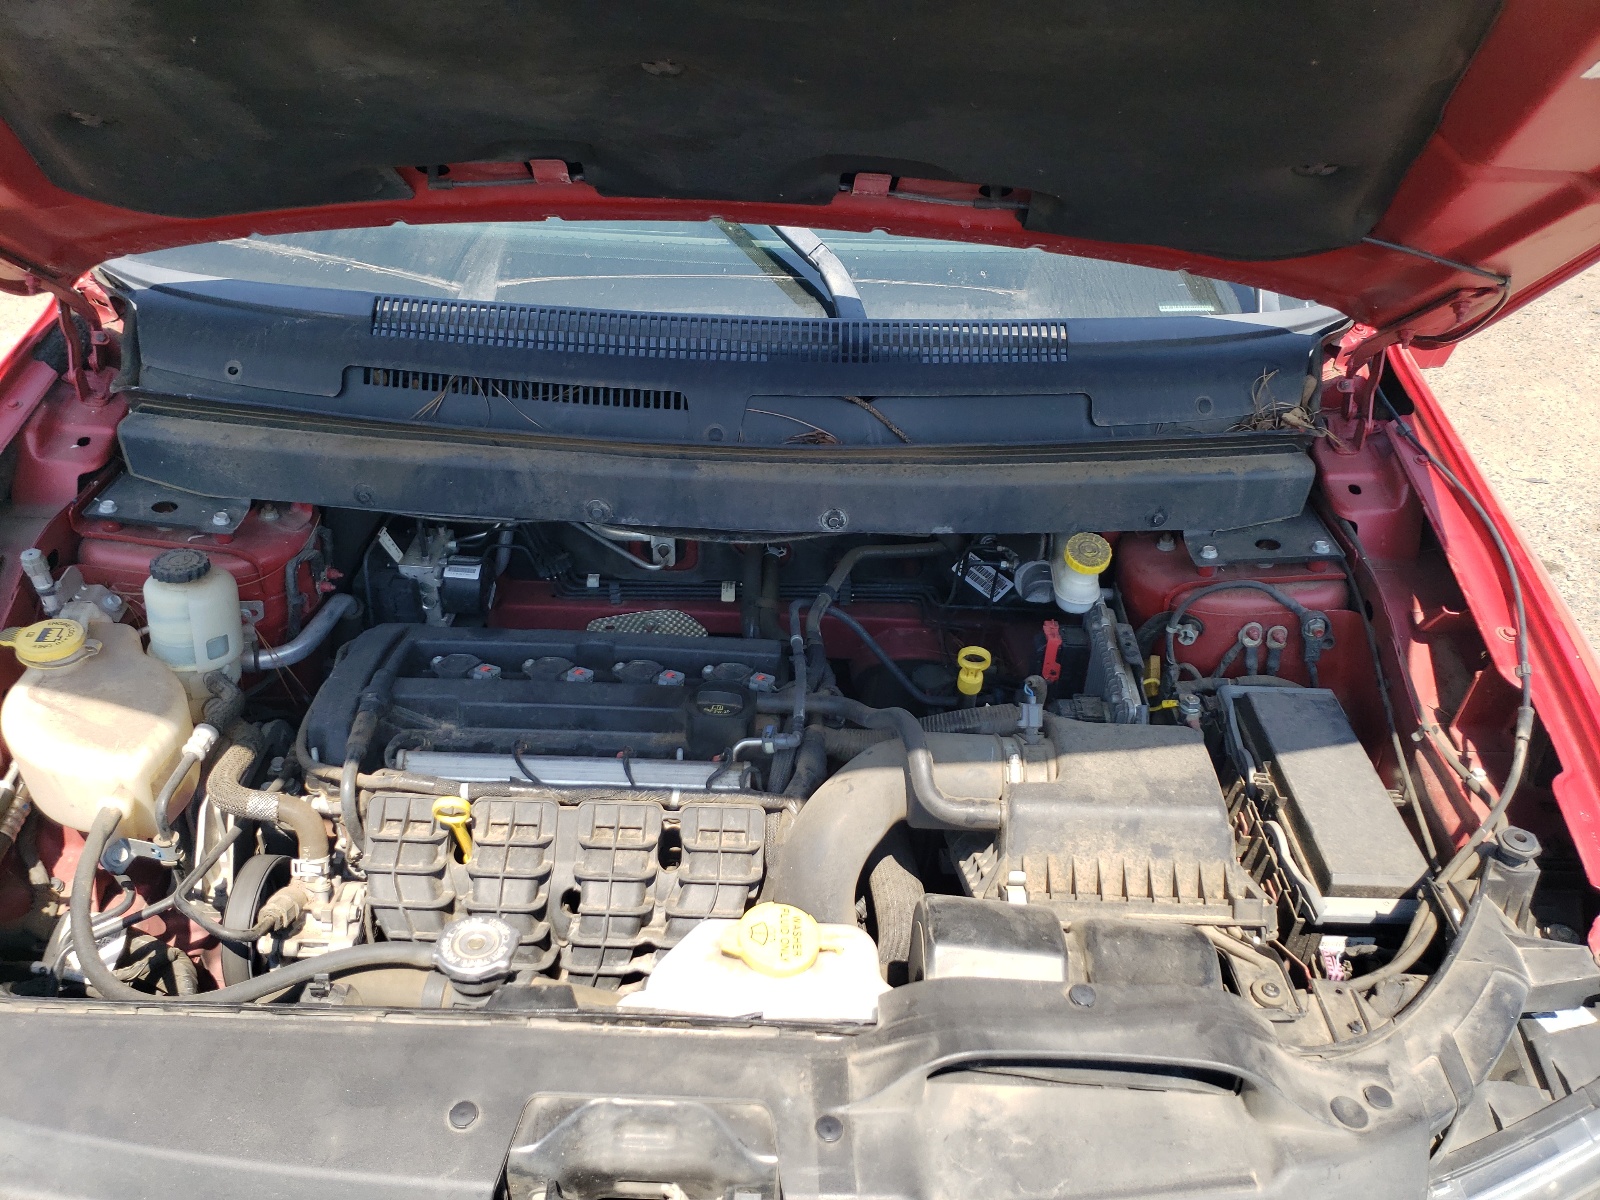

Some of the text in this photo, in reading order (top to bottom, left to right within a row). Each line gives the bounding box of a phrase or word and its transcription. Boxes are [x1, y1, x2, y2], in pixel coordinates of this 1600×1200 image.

[780, 908, 790, 963] FLUID ONLY
[792, 916, 802, 957] WASHER
